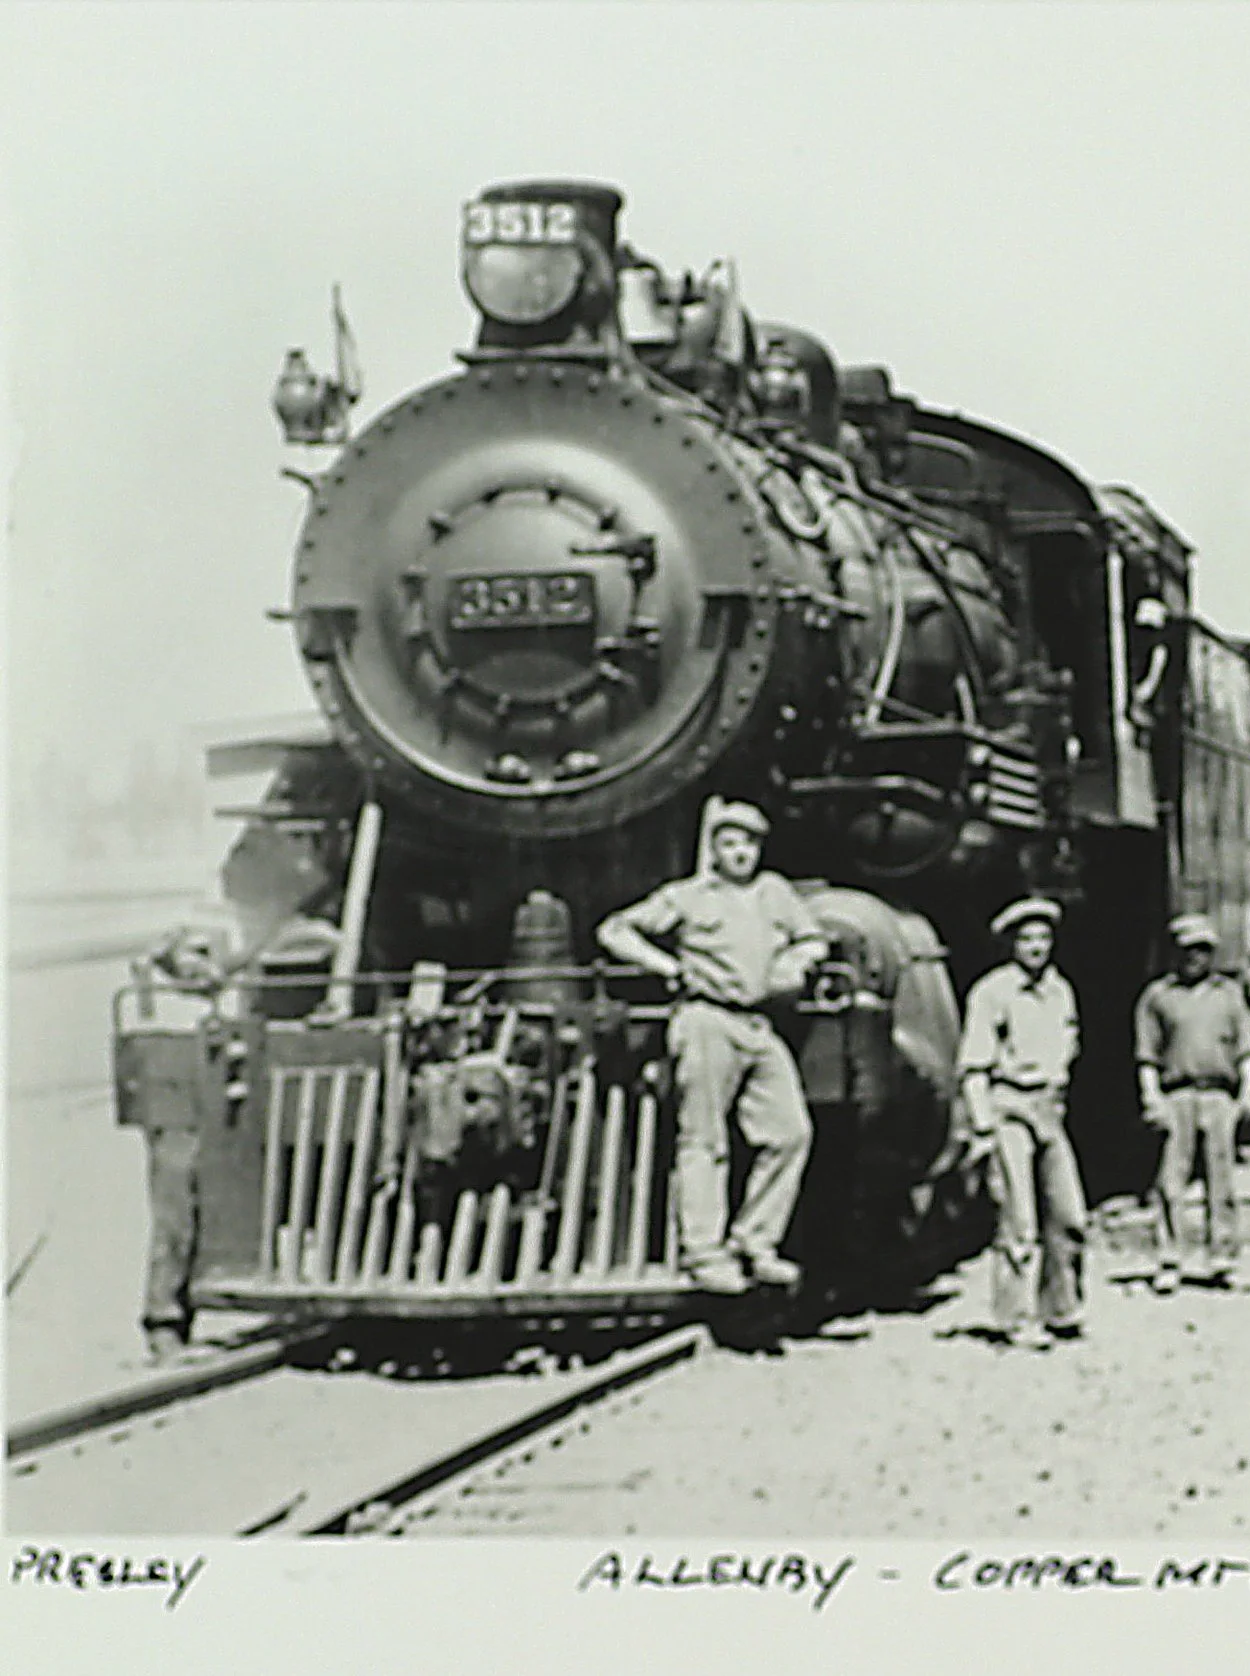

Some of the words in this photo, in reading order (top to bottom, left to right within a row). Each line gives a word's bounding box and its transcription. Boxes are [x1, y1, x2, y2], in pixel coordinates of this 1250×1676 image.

[468, 203, 576, 243] 3512
[460, 575, 579, 617] 3512
[578, 1551, 856, 1611] ALLENBY
[933, 1551, 1142, 1590] COPPER
